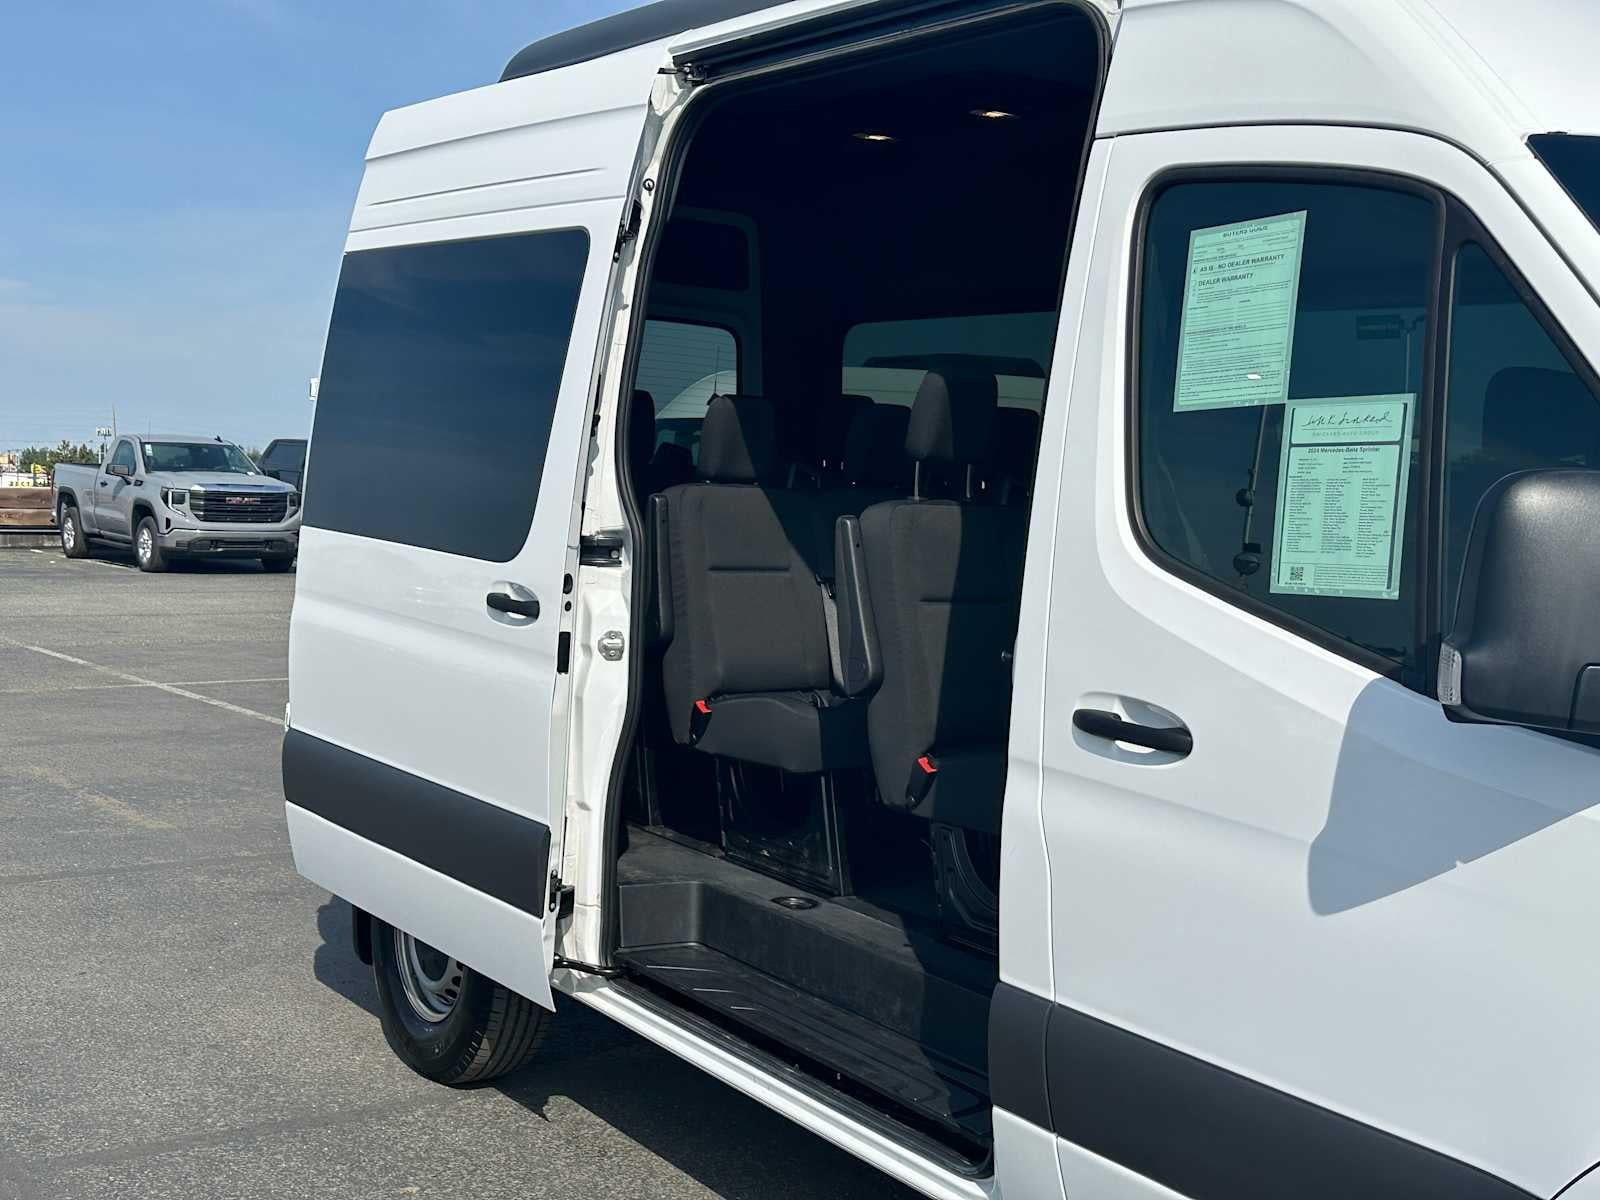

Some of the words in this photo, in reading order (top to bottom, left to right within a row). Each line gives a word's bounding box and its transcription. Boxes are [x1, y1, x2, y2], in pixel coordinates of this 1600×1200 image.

[1228, 260, 1250, 268] DEALER
[1251, 255, 1285, 264] WARRANTY
[1198, 279, 1220, 287] DEALER
[1221, 273, 1253, 281] WARRANTY
